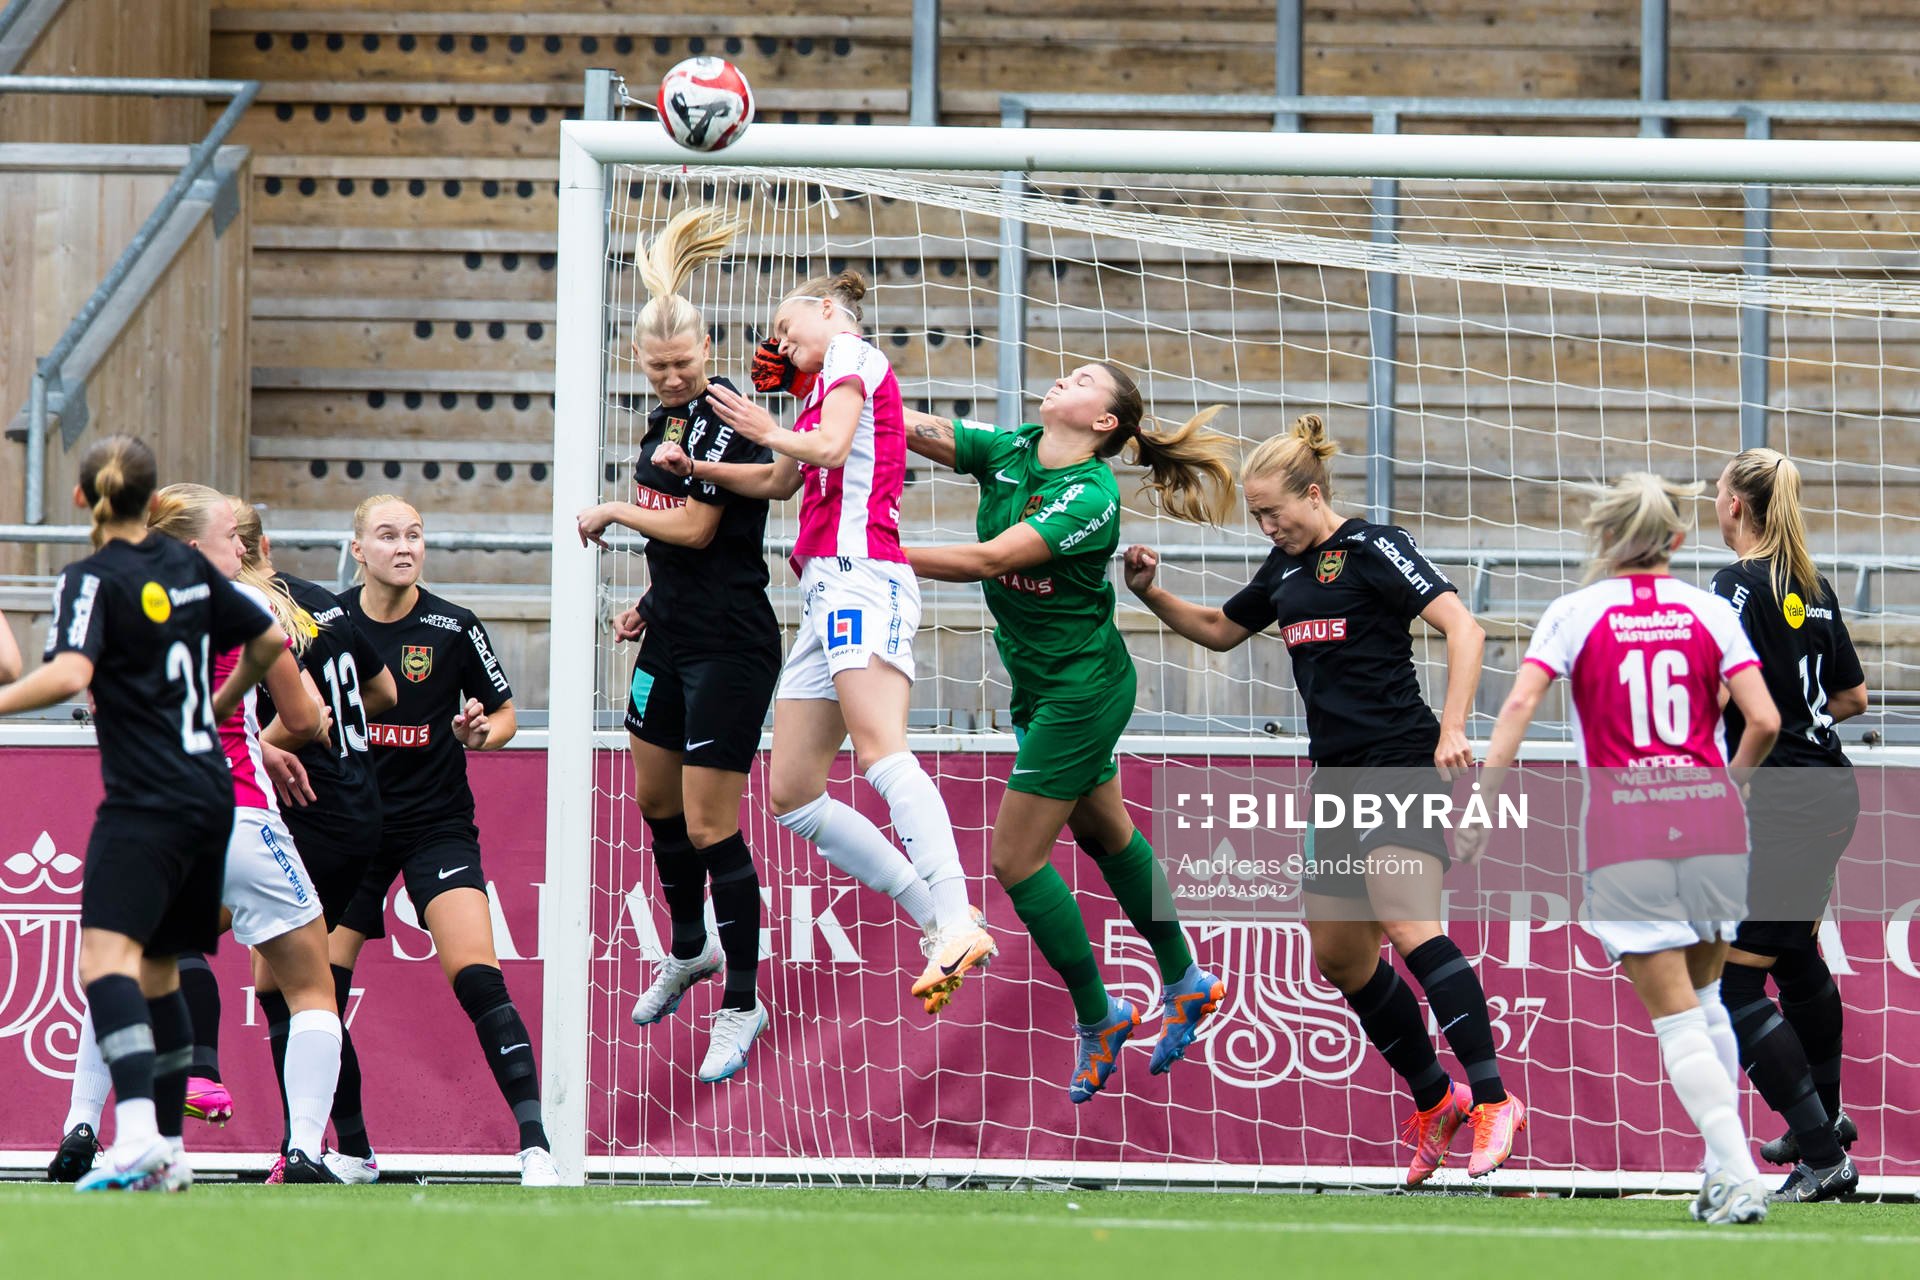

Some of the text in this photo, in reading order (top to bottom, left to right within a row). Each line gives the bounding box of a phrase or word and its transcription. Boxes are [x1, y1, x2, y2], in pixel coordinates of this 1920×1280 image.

[1059, 499, 1117, 551] stadium
[1373, 536, 1434, 596] stadium
[428, 614, 458, 625] NORDIC
[1609, 610, 1693, 631] Hemköp
[1785, 604, 1804, 617] Yale
[420, 617, 462, 632] WELLNESS
[1284, 620, 1346, 644] UHAUS
[467, 625, 509, 693] stadium
[323, 652, 369, 759] 13
[1618, 648, 1691, 748] 16
[368, 724, 430, 745] HAUS
[1615, 766, 1711, 786] WELLNESS
[1648, 782, 1727, 801] MOTOR
[240, 985, 366, 1040] 17
